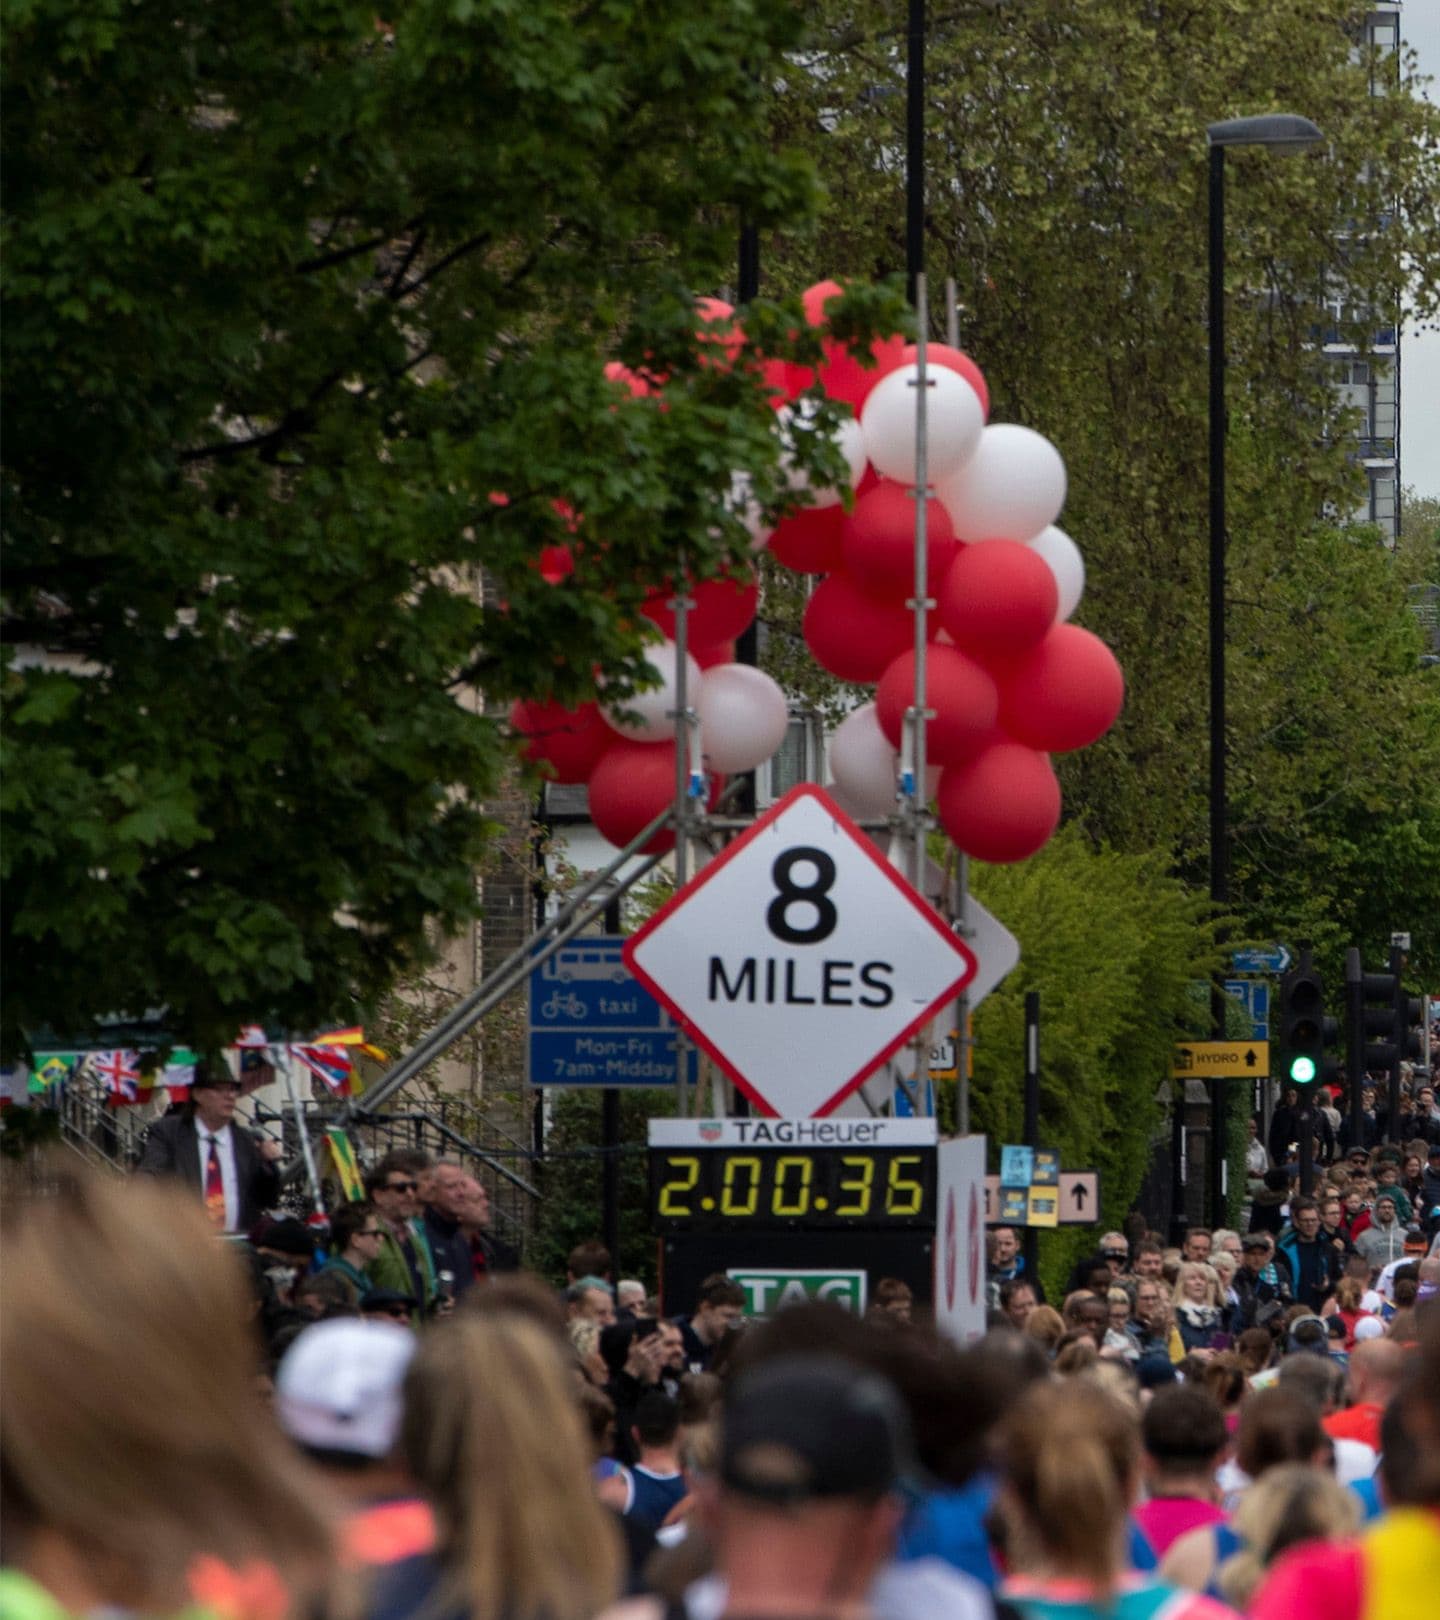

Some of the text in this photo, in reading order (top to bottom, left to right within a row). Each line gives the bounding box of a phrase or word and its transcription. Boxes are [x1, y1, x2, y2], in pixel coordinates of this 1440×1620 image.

[766, 846, 839, 944] 8
[708, 956, 895, 1008] MILES
[599, 997, 637, 1015] taxi
[575, 1039, 653, 1055] Mon-Fri
[1196, 1053, 1239, 1065] HYDRO
[553, 1059, 676, 1079] 7am-Midday
